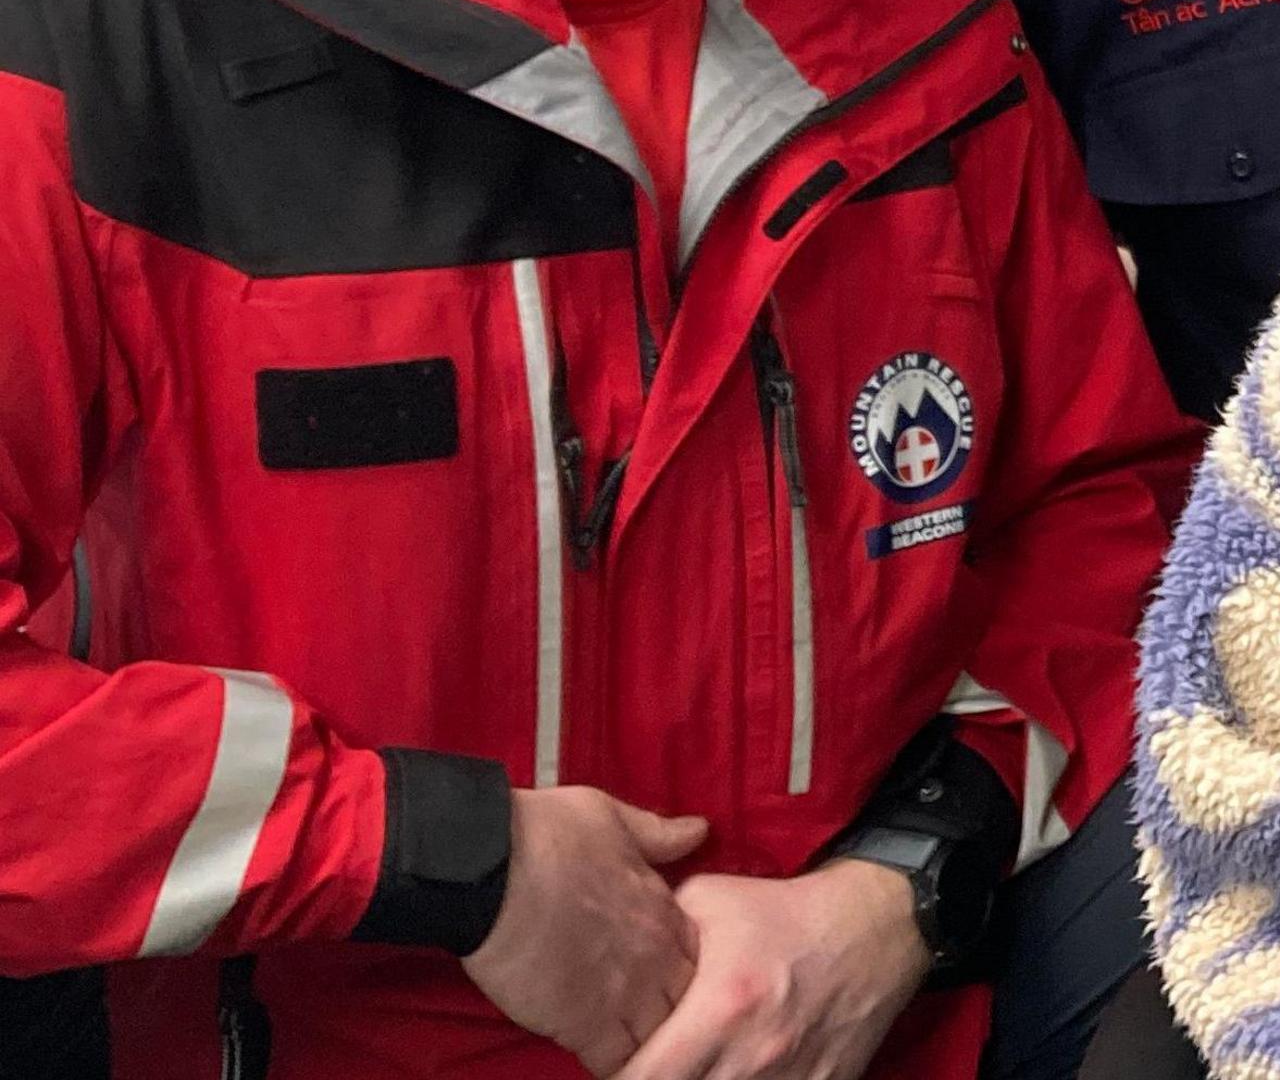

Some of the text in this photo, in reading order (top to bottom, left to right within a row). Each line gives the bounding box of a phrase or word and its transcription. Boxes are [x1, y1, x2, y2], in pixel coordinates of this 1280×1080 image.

[1175, 1, 1208, 22] ac
[851, 353, 918, 477] MOUNTAIN
[928, 357, 974, 450] RESCUE
[890, 505, 964, 537] WESTERN
[892, 520, 965, 550] BEACONS
